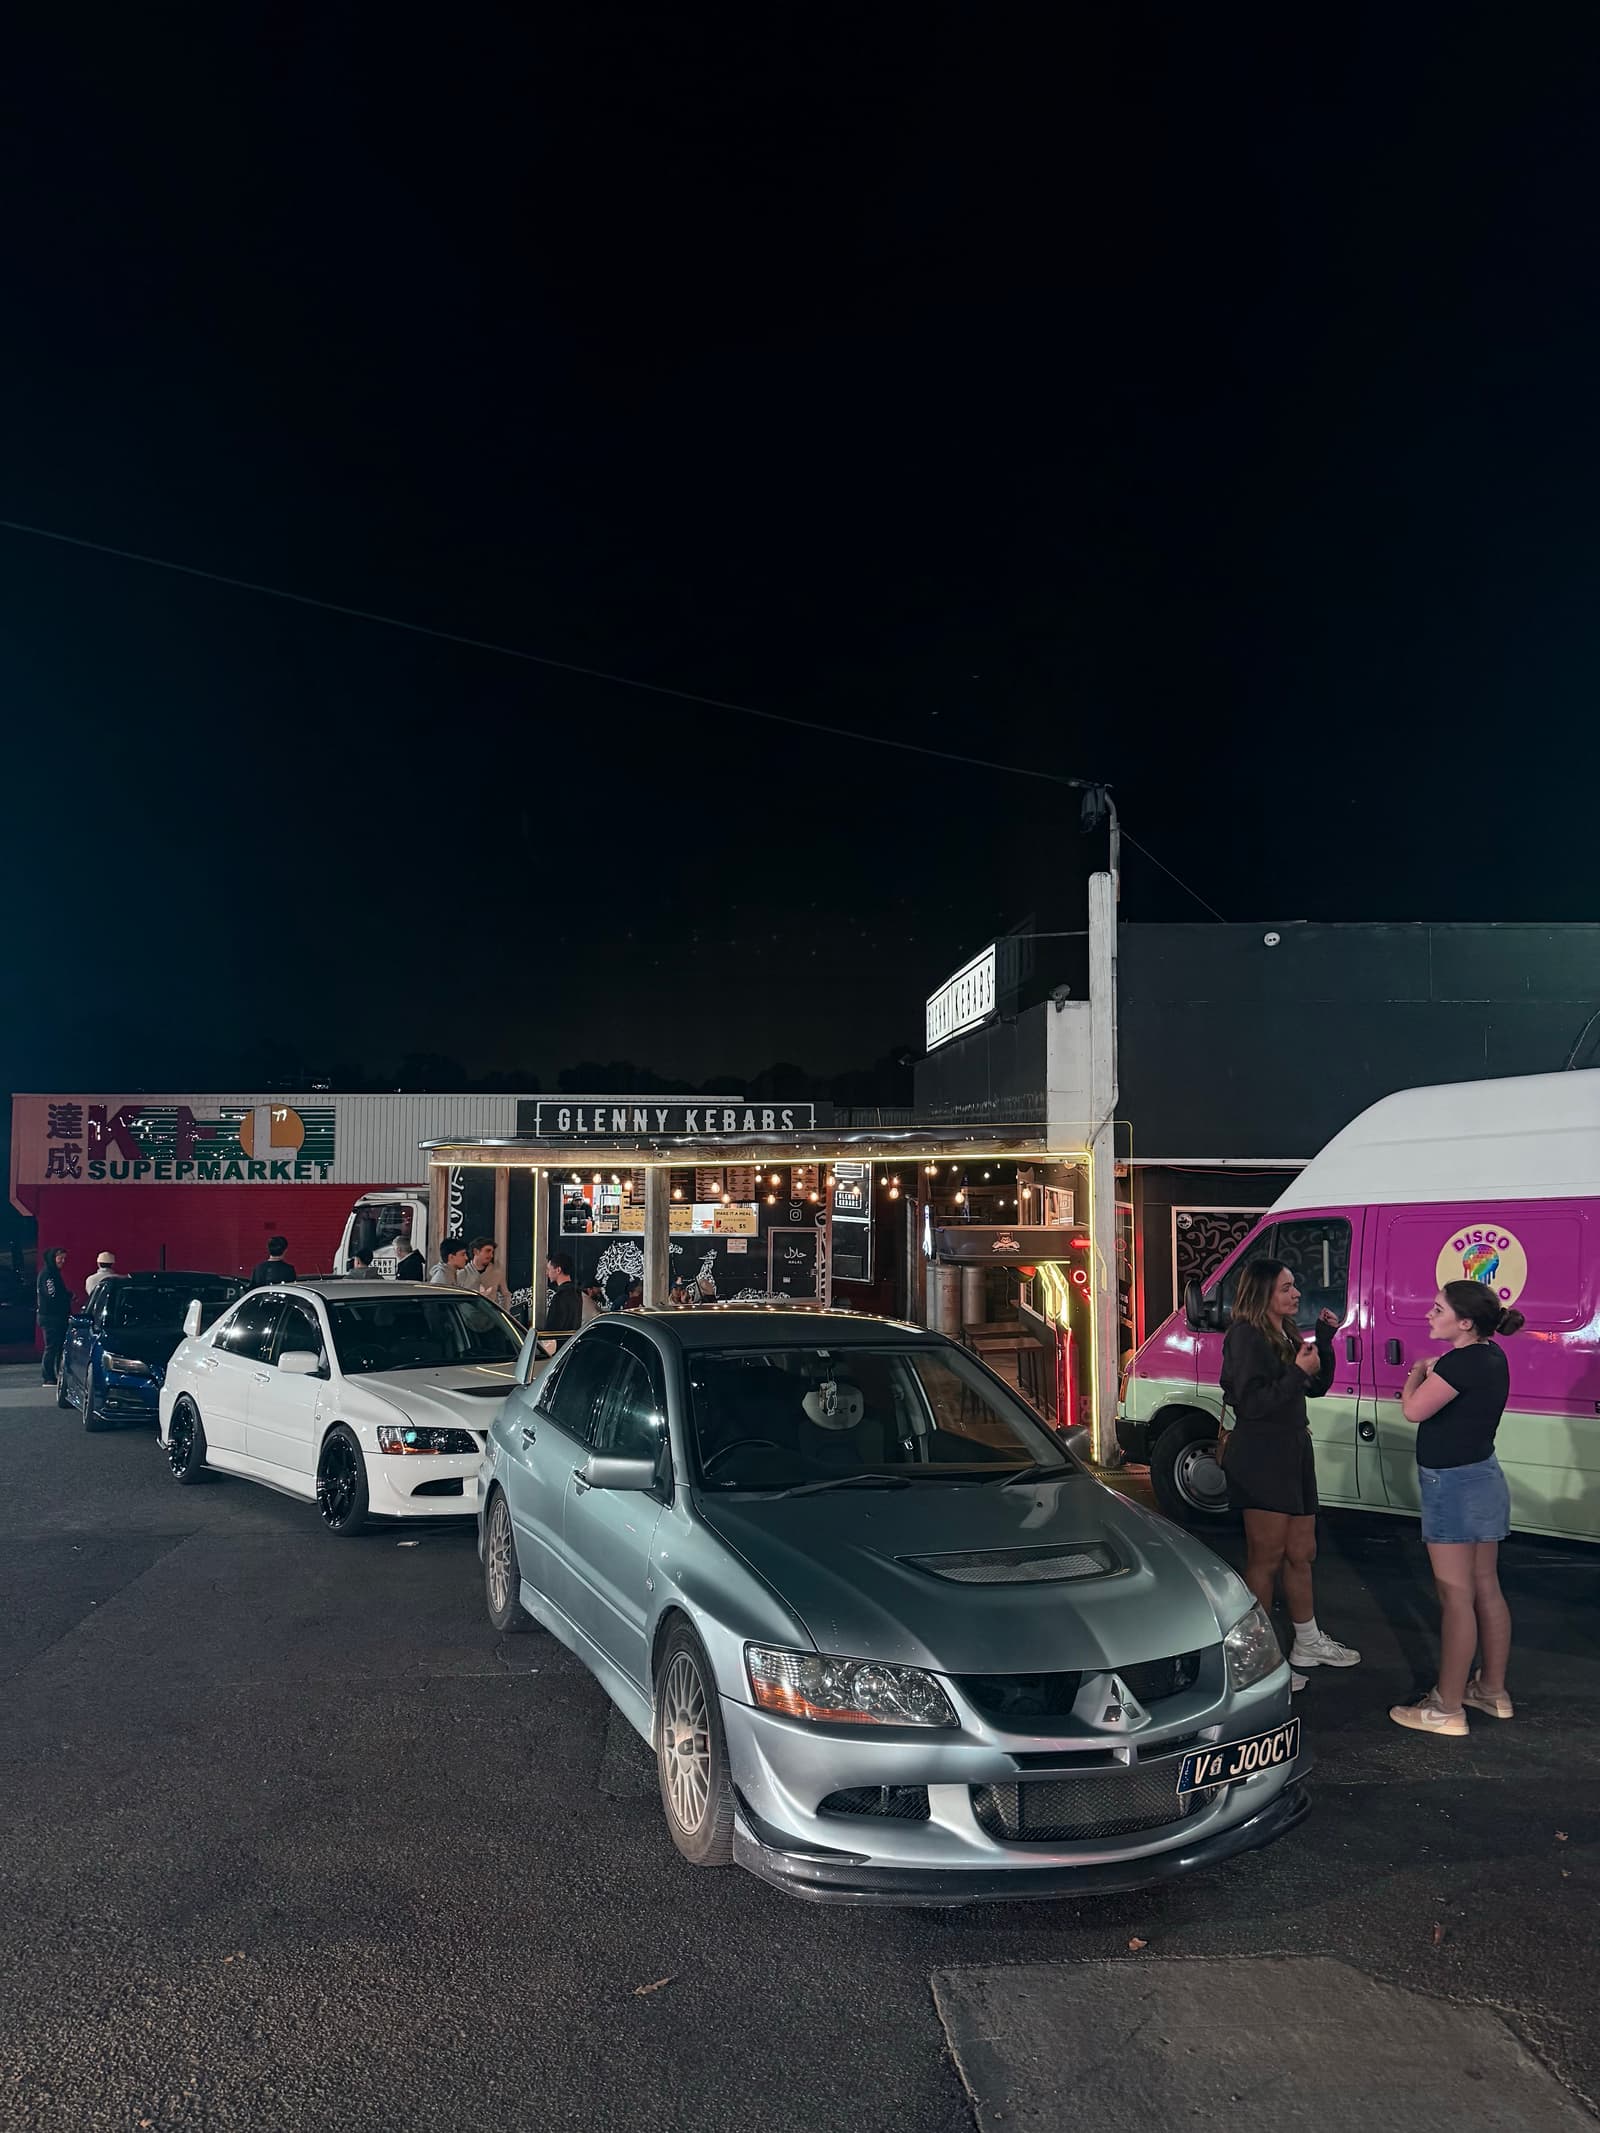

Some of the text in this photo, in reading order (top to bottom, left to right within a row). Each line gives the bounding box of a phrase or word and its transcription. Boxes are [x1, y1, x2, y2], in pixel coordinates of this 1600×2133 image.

[558, 1108, 794, 1133] GLENNY KEBABS
[45, 1102, 83, 1180] 達成
[87, 1160, 335, 1181] SUPERMARKET
[784, 1246, 807, 1259] حلال
[1453, 1231, 1510, 1252] DISCO
[1229, 1726, 1294, 1775] JOOCY
